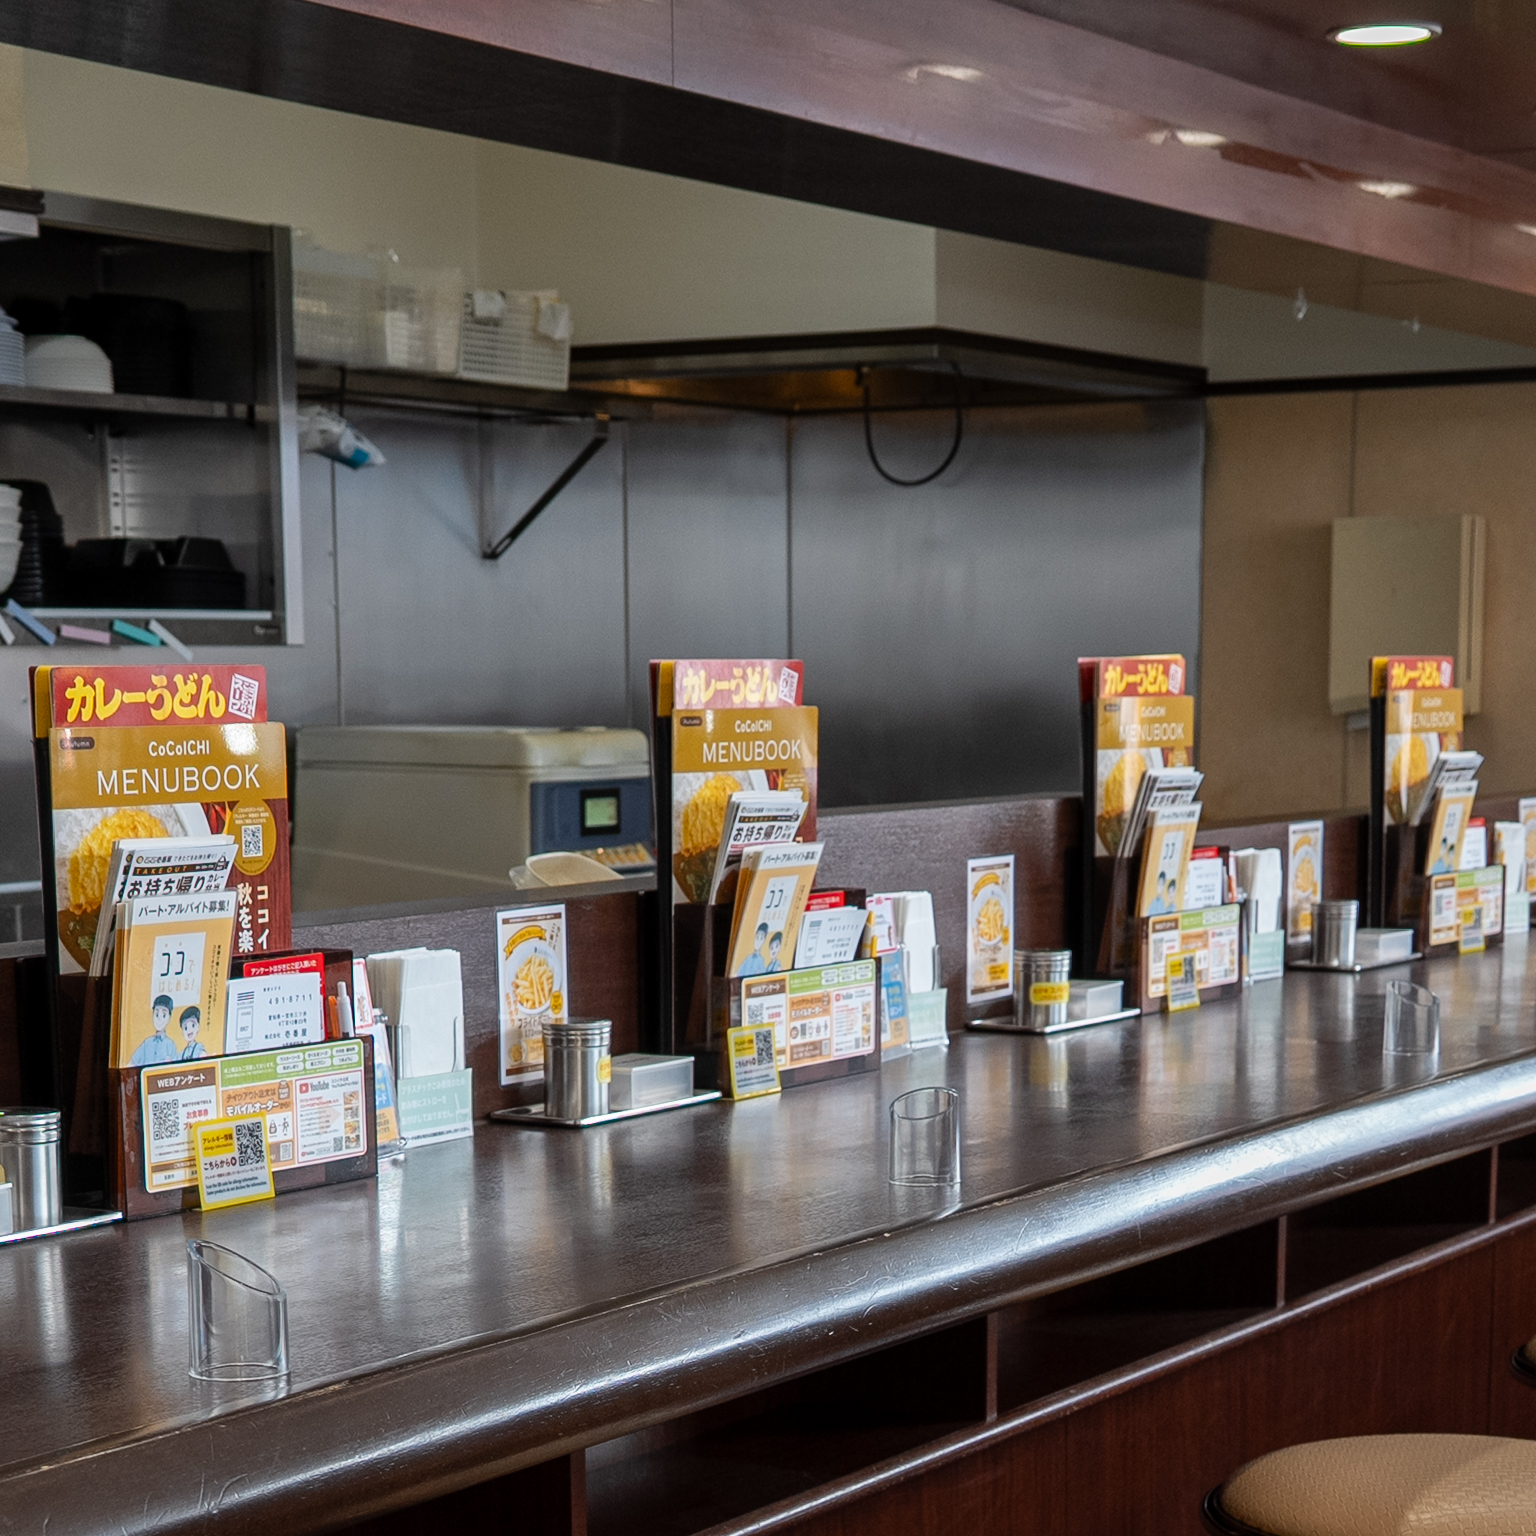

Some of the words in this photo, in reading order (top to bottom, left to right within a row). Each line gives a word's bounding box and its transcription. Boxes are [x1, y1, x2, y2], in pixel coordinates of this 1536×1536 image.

[682, 665, 778, 705] カレーうどん
[1105, 663, 1168, 695] カレーうどん
[65, 673, 226, 723] カレーうどん
[735, 720, 772, 733] CoCoICHI
[1119, 722, 1184, 742] MENUBOOK
[148, 740, 210, 757] CoCoICHI
[703, 739, 801, 763] MENUBOOK
[97, 763, 261, 796] MENUBOOK
[733, 825, 784, 842] お持ち帰り
[127, 875, 205, 899] お持ち帰り
[284, 1028, 307, 1039] 壱番屋
[157, 1073, 206, 1088] WEBアンケート
[310, 1081, 330, 1092] YouTube
[226, 1100, 279, 1116] モバイルオーダー
[204, 1158, 230, 1170] こちらから
